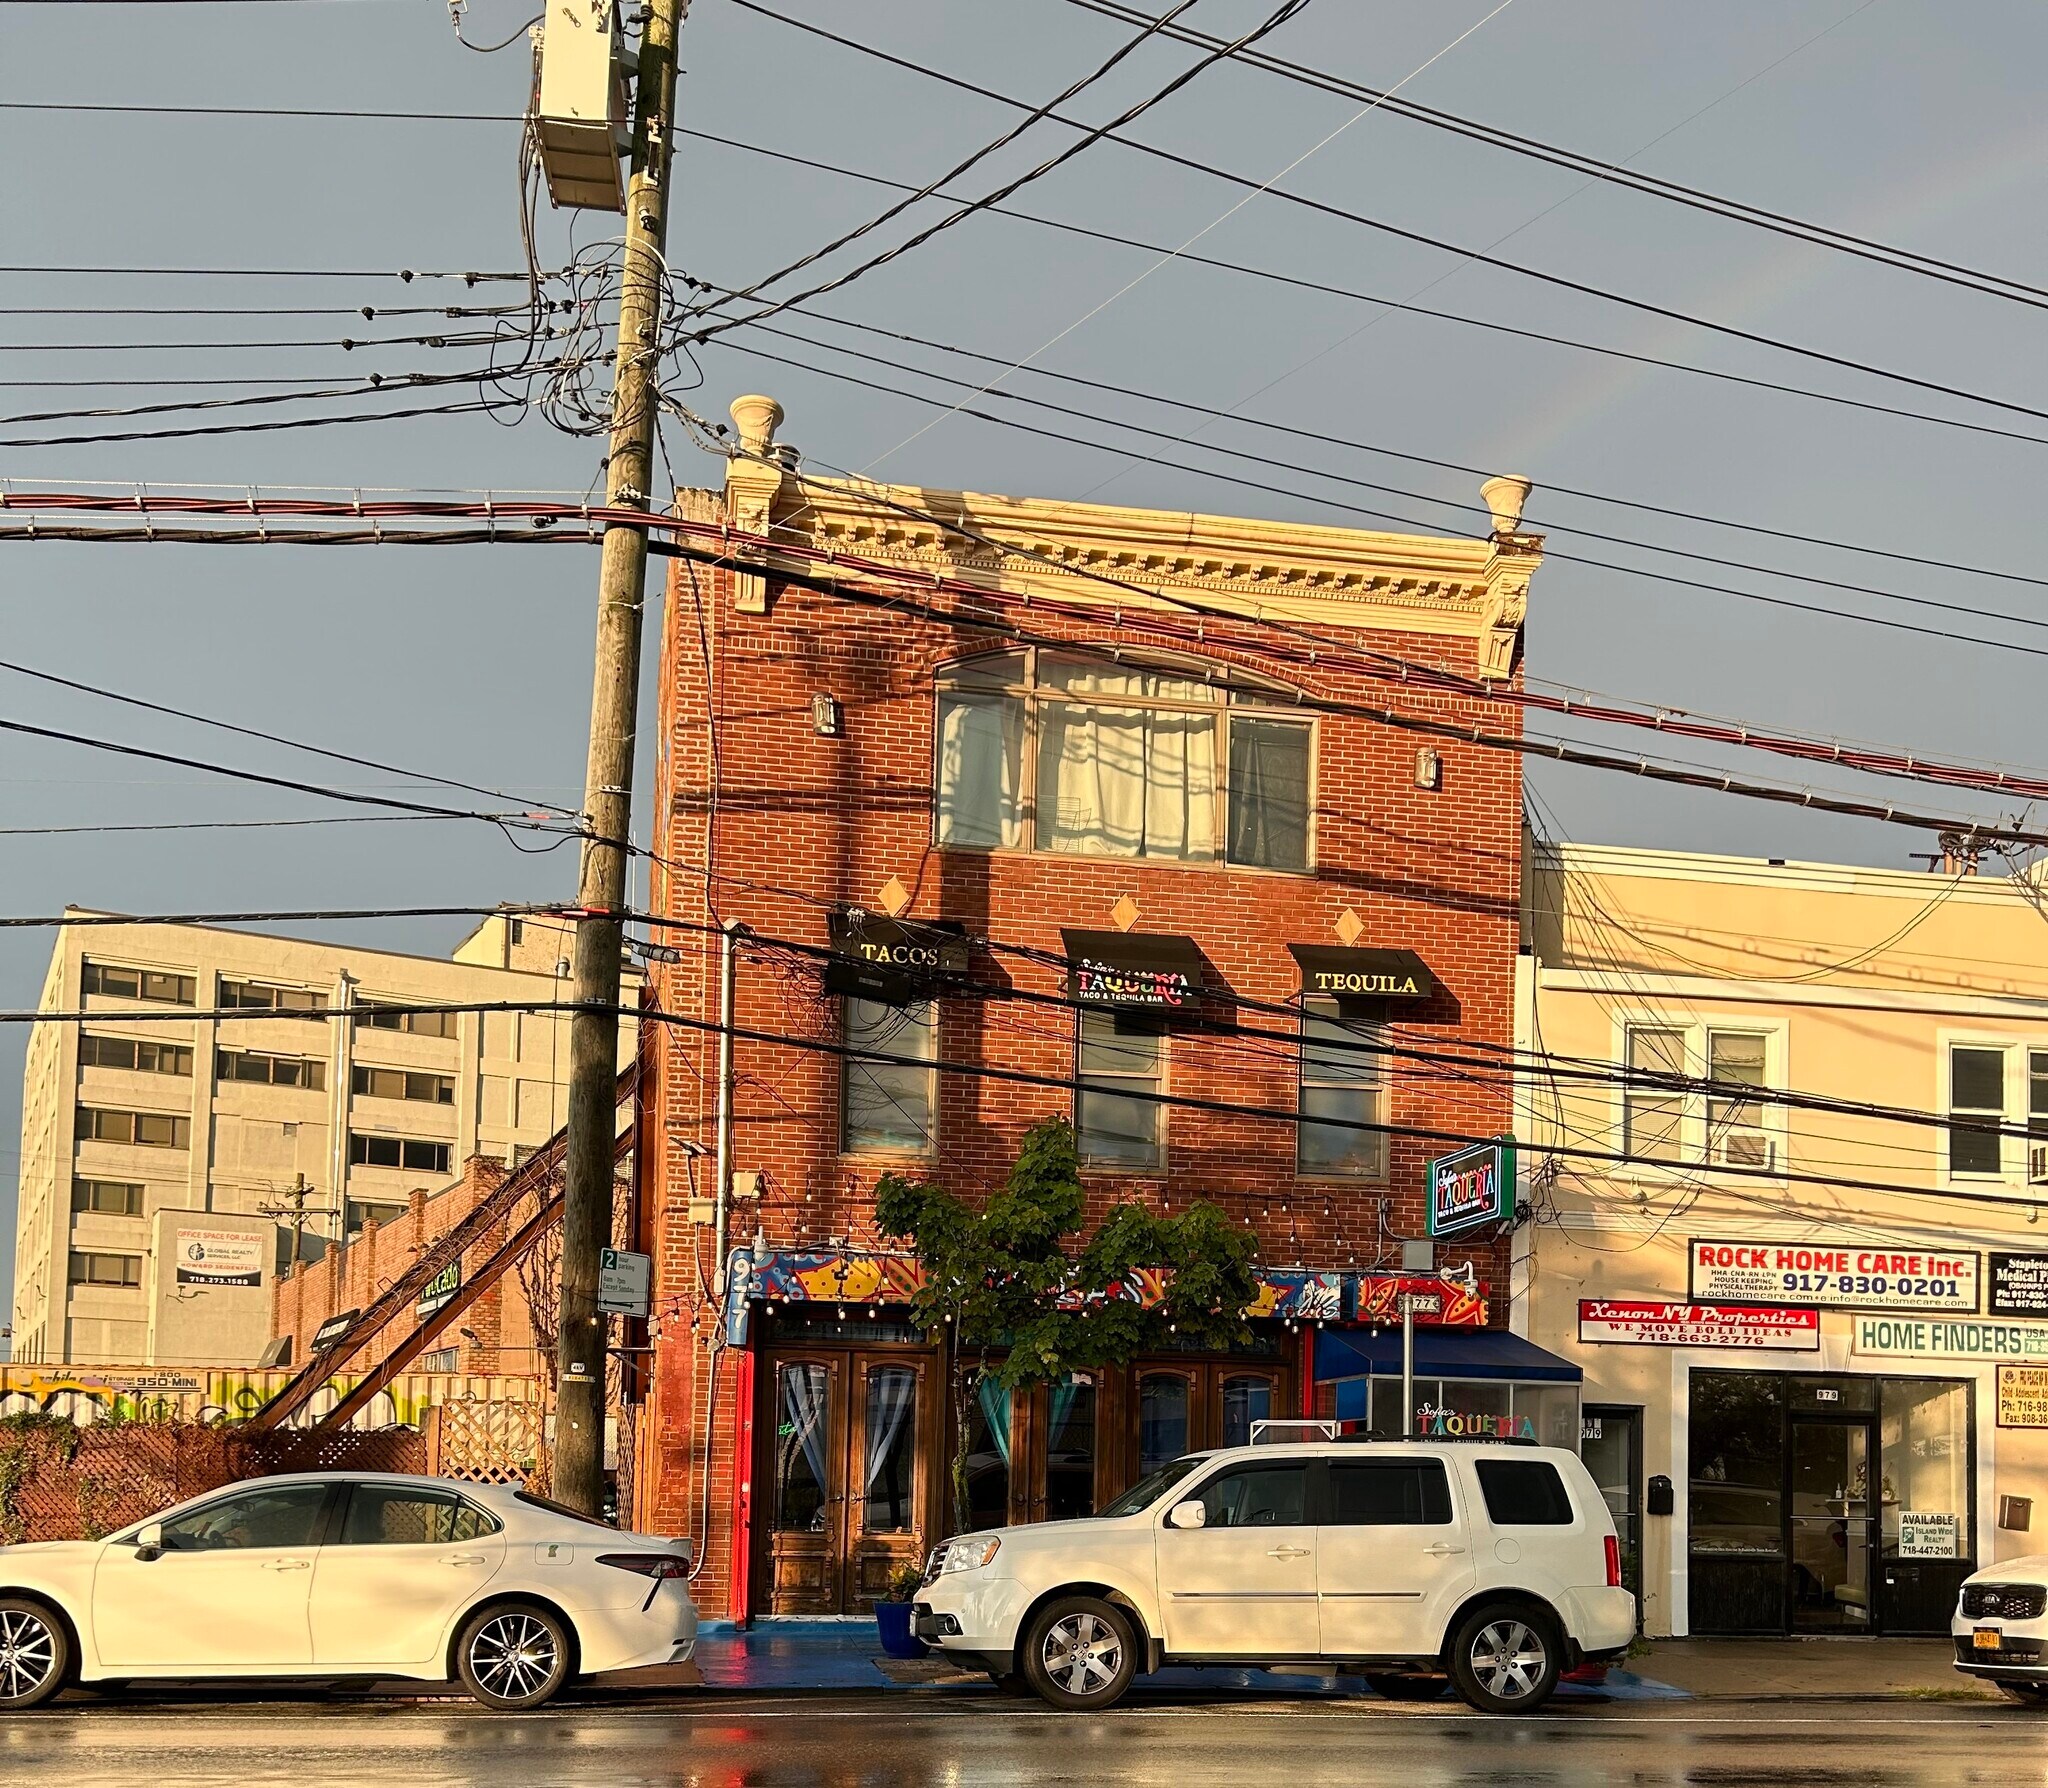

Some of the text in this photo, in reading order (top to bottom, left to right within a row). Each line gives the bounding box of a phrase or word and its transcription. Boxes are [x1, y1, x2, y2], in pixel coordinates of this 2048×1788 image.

[860, 943, 938, 966] TACOS
[1315, 972, 1419, 993] TEQUILA
[1079, 991, 1101, 1000] TACO
[1102, 992, 1109, 1000] &
[1147, 995, 1163, 1003] BAR
[1438, 1168, 1495, 1210] TAQUERIA
[178, 1231, 262, 1243] OFFICE SPACE FOR LEASE
[605, 1252, 614, 1268] 2
[1699, 1245, 1769, 1270] ROCK
[1775, 1248, 1850, 1275] HOME
[1857, 1252, 1922, 1276] CARE
[1714, 1276, 1774, 1286] HOUSE KEEPING
[1996, 1268, 2038, 1283] Medical
[1708, 1282, 1779, 1292] PHYSICAL THERAPY
[1783, 1273, 1959, 1297] 917-830-0201
[734, 1258, 750, 1329] 977
[1699, 1306, 1810, 1326] Properties
[1608, 1322, 1792, 1338] WE MOVE BOLD IDEAS
[1862, 1321, 2046, 1354] HOME FINDERS USA
[1635, 1332, 1764, 1345] 718-663-2776
[1818, 1391, 1837, 1400] 979
[1417, 1402, 1456, 1418] Sofia's
[2001, 1399, 2015, 1411] Ph:
[1416, 1411, 1537, 1438] TAQUERIA
[2005, 1412, 2020, 1424] Fax:
[1902, 1515, 1953, 1525] AVAILABLE
[1902, 1545, 1953, 1555] 718-447-2100
